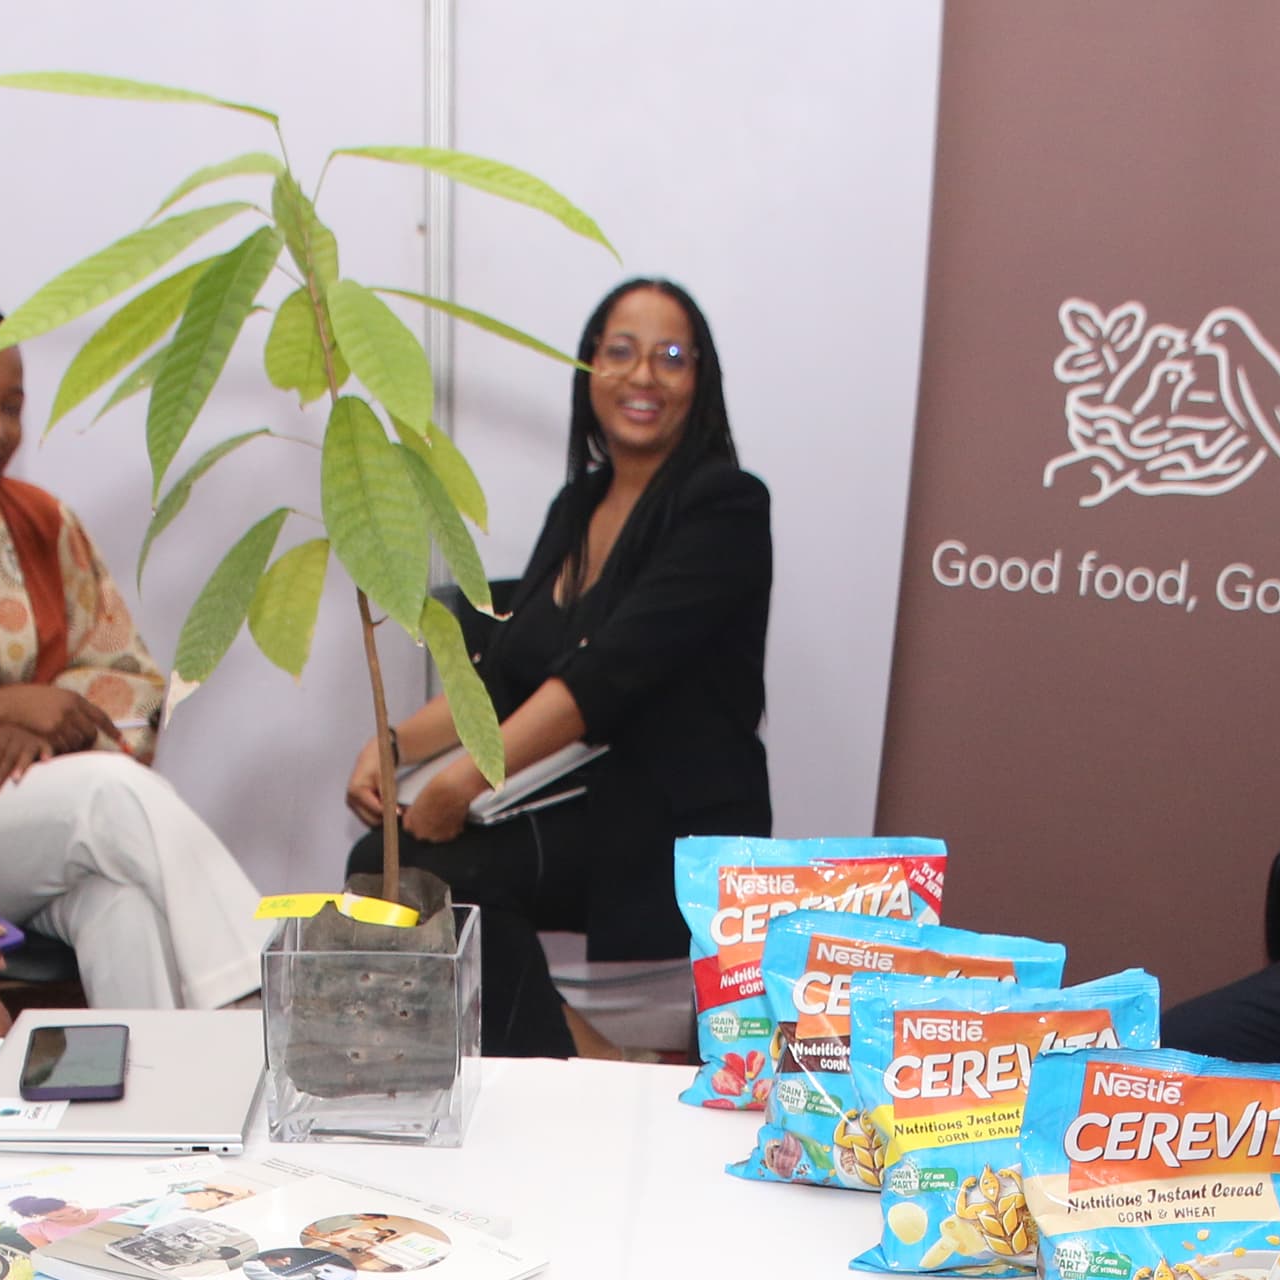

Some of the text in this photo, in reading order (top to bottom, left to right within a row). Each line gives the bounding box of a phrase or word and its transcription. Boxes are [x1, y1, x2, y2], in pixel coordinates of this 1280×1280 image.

[931, 539, 1062, 596] Good
[1078, 552, 1197, 613] food,
[726, 874, 798, 896] Nestlé
[816, 944, 894, 971] Nestlé
[902, 1017, 984, 1042] Nestlé
[1093, 1071, 1185, 1106] Nestlé
[894, 1109, 1021, 1138] Nutritious Instant
[937, 1132, 970, 1144] CORN
[1067, 1181, 1264, 1214] Nutritious Instant Cereal
[1117, 1210, 1153, 1224] CORN
[1173, 1205, 1217, 1219] WHEAT
